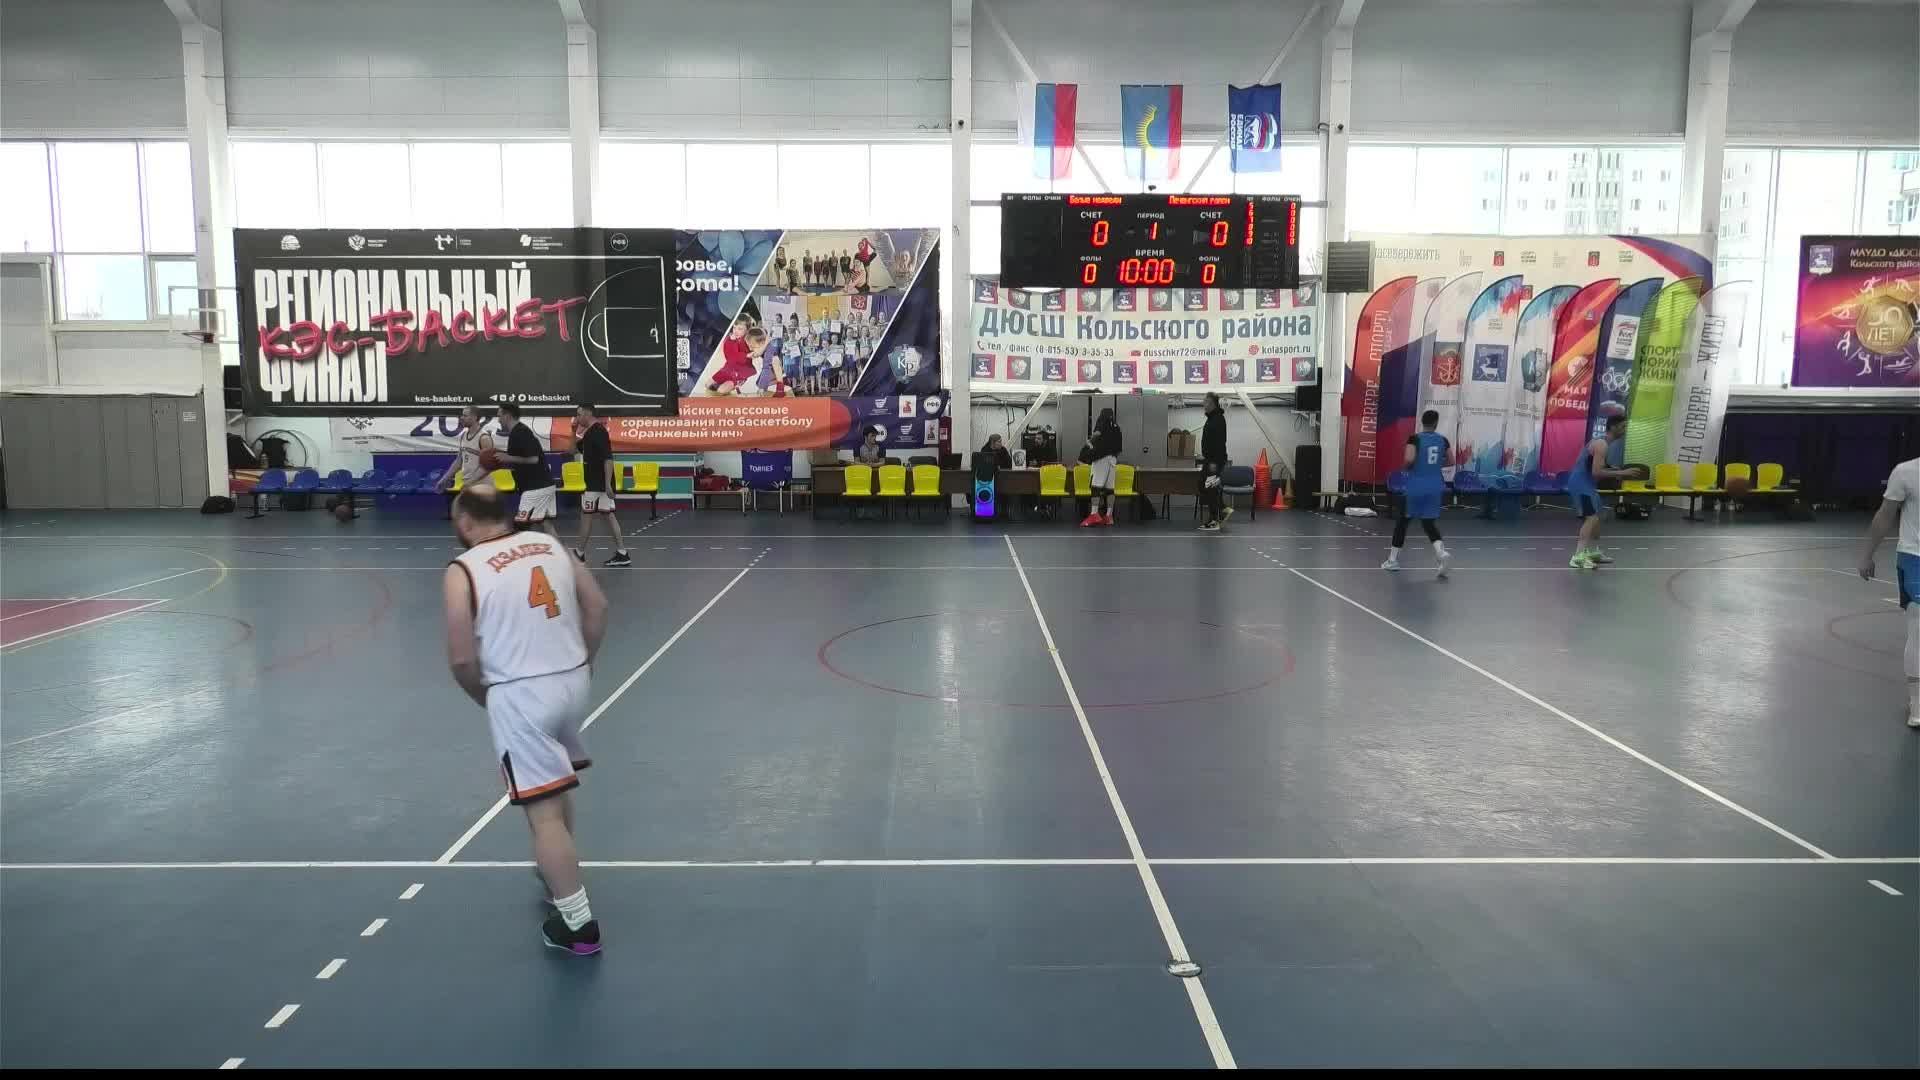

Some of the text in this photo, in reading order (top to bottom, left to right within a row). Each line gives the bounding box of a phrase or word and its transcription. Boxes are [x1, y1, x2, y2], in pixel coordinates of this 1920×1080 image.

[1094, 220, 1109, 246] 0
[1152, 222, 1158, 240] 1
[1212, 221, 1228, 246] 0
[1889, 248, 1920, 256] «ДЮС
[1084, 264, 1096, 284] 0
[1120, 258, 1174, 284] 10:00
[1203, 264, 1216, 284] 0
[254, 261, 531, 332] РЕГИОНАЛЬНЫЙ
[259, 296, 588, 361] КЭС-БАСКЕТ
[979, 307, 1312, 344] ДЮСШ Кольского района
[1262, 345, 1311, 355] kolasport.ru
[1564, 385, 1588, 396] МАЯ
[725, 406, 788, 416] массовые
[1550, 398, 1588, 410] ПОБЕД
[1683, 386, 1712, 440] СЕВЕРЕ
[621, 417, 814, 428] соревнования по баскетболу
[620, 428, 744, 438] «Оранжевый мяч»
[1358, 439, 1376, 459] НА
[1428, 446, 1440, 464] 6
[1678, 446, 1702, 464] НА
[528, 566, 562, 619] 4
